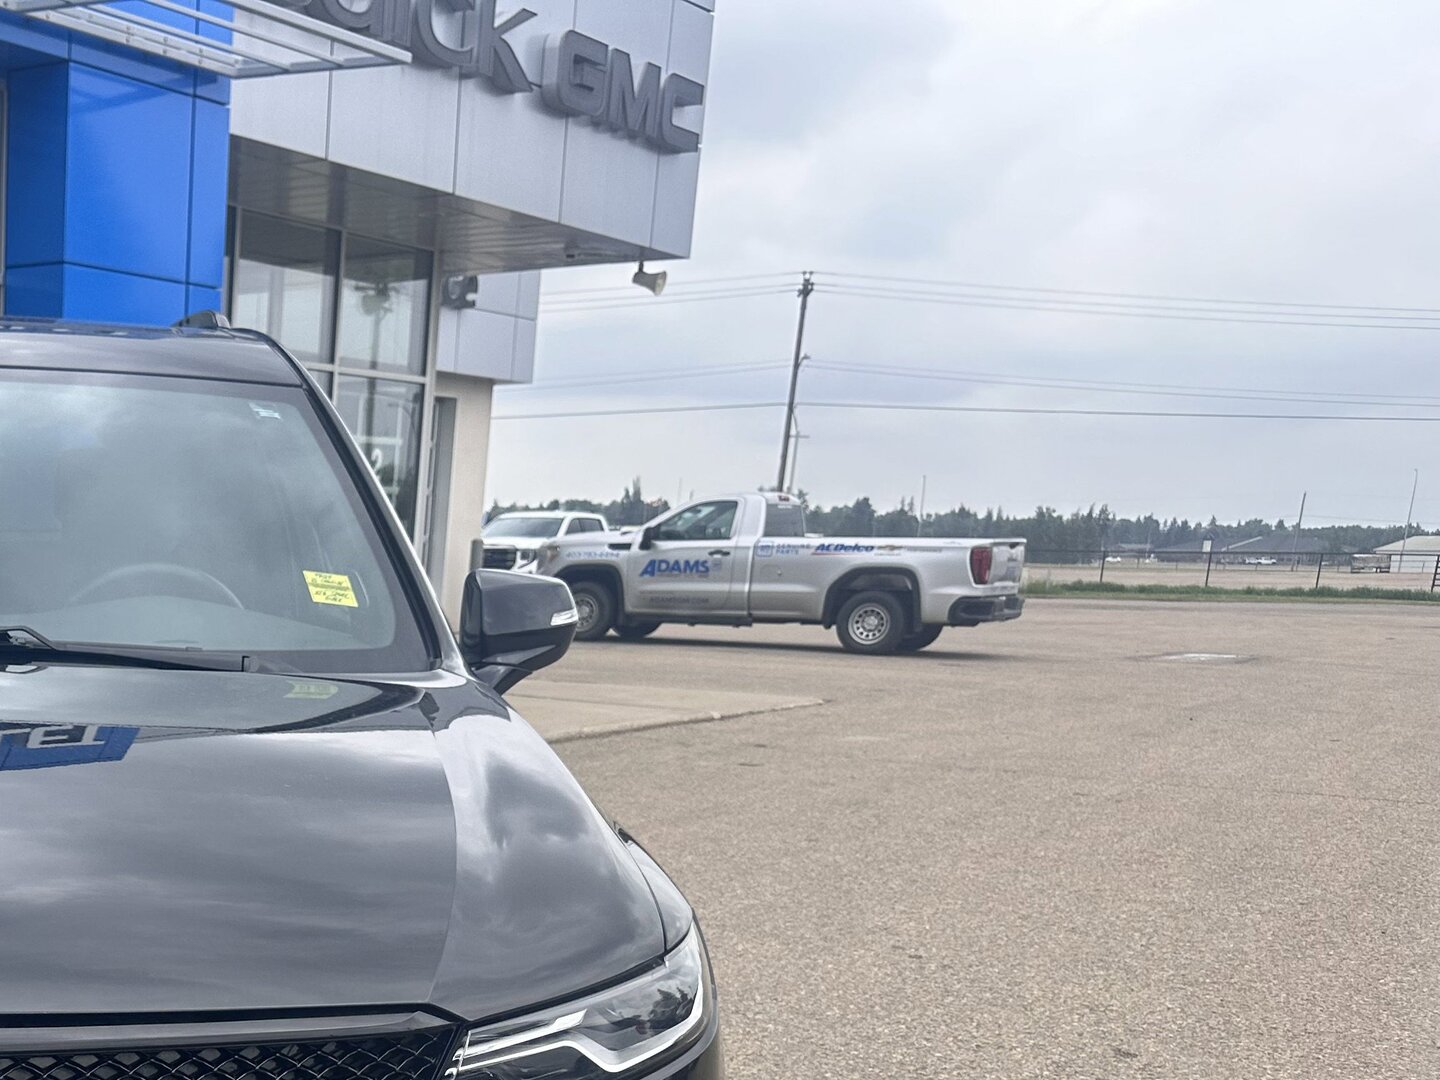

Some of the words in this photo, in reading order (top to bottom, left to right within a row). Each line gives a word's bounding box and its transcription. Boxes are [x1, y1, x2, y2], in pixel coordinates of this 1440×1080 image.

[302, 0, 539, 93] ICK
[550, 30, 706, 152] GMC
[815, 543, 875, 553] ACDelco
[639, 559, 710, 577] ADAMS
